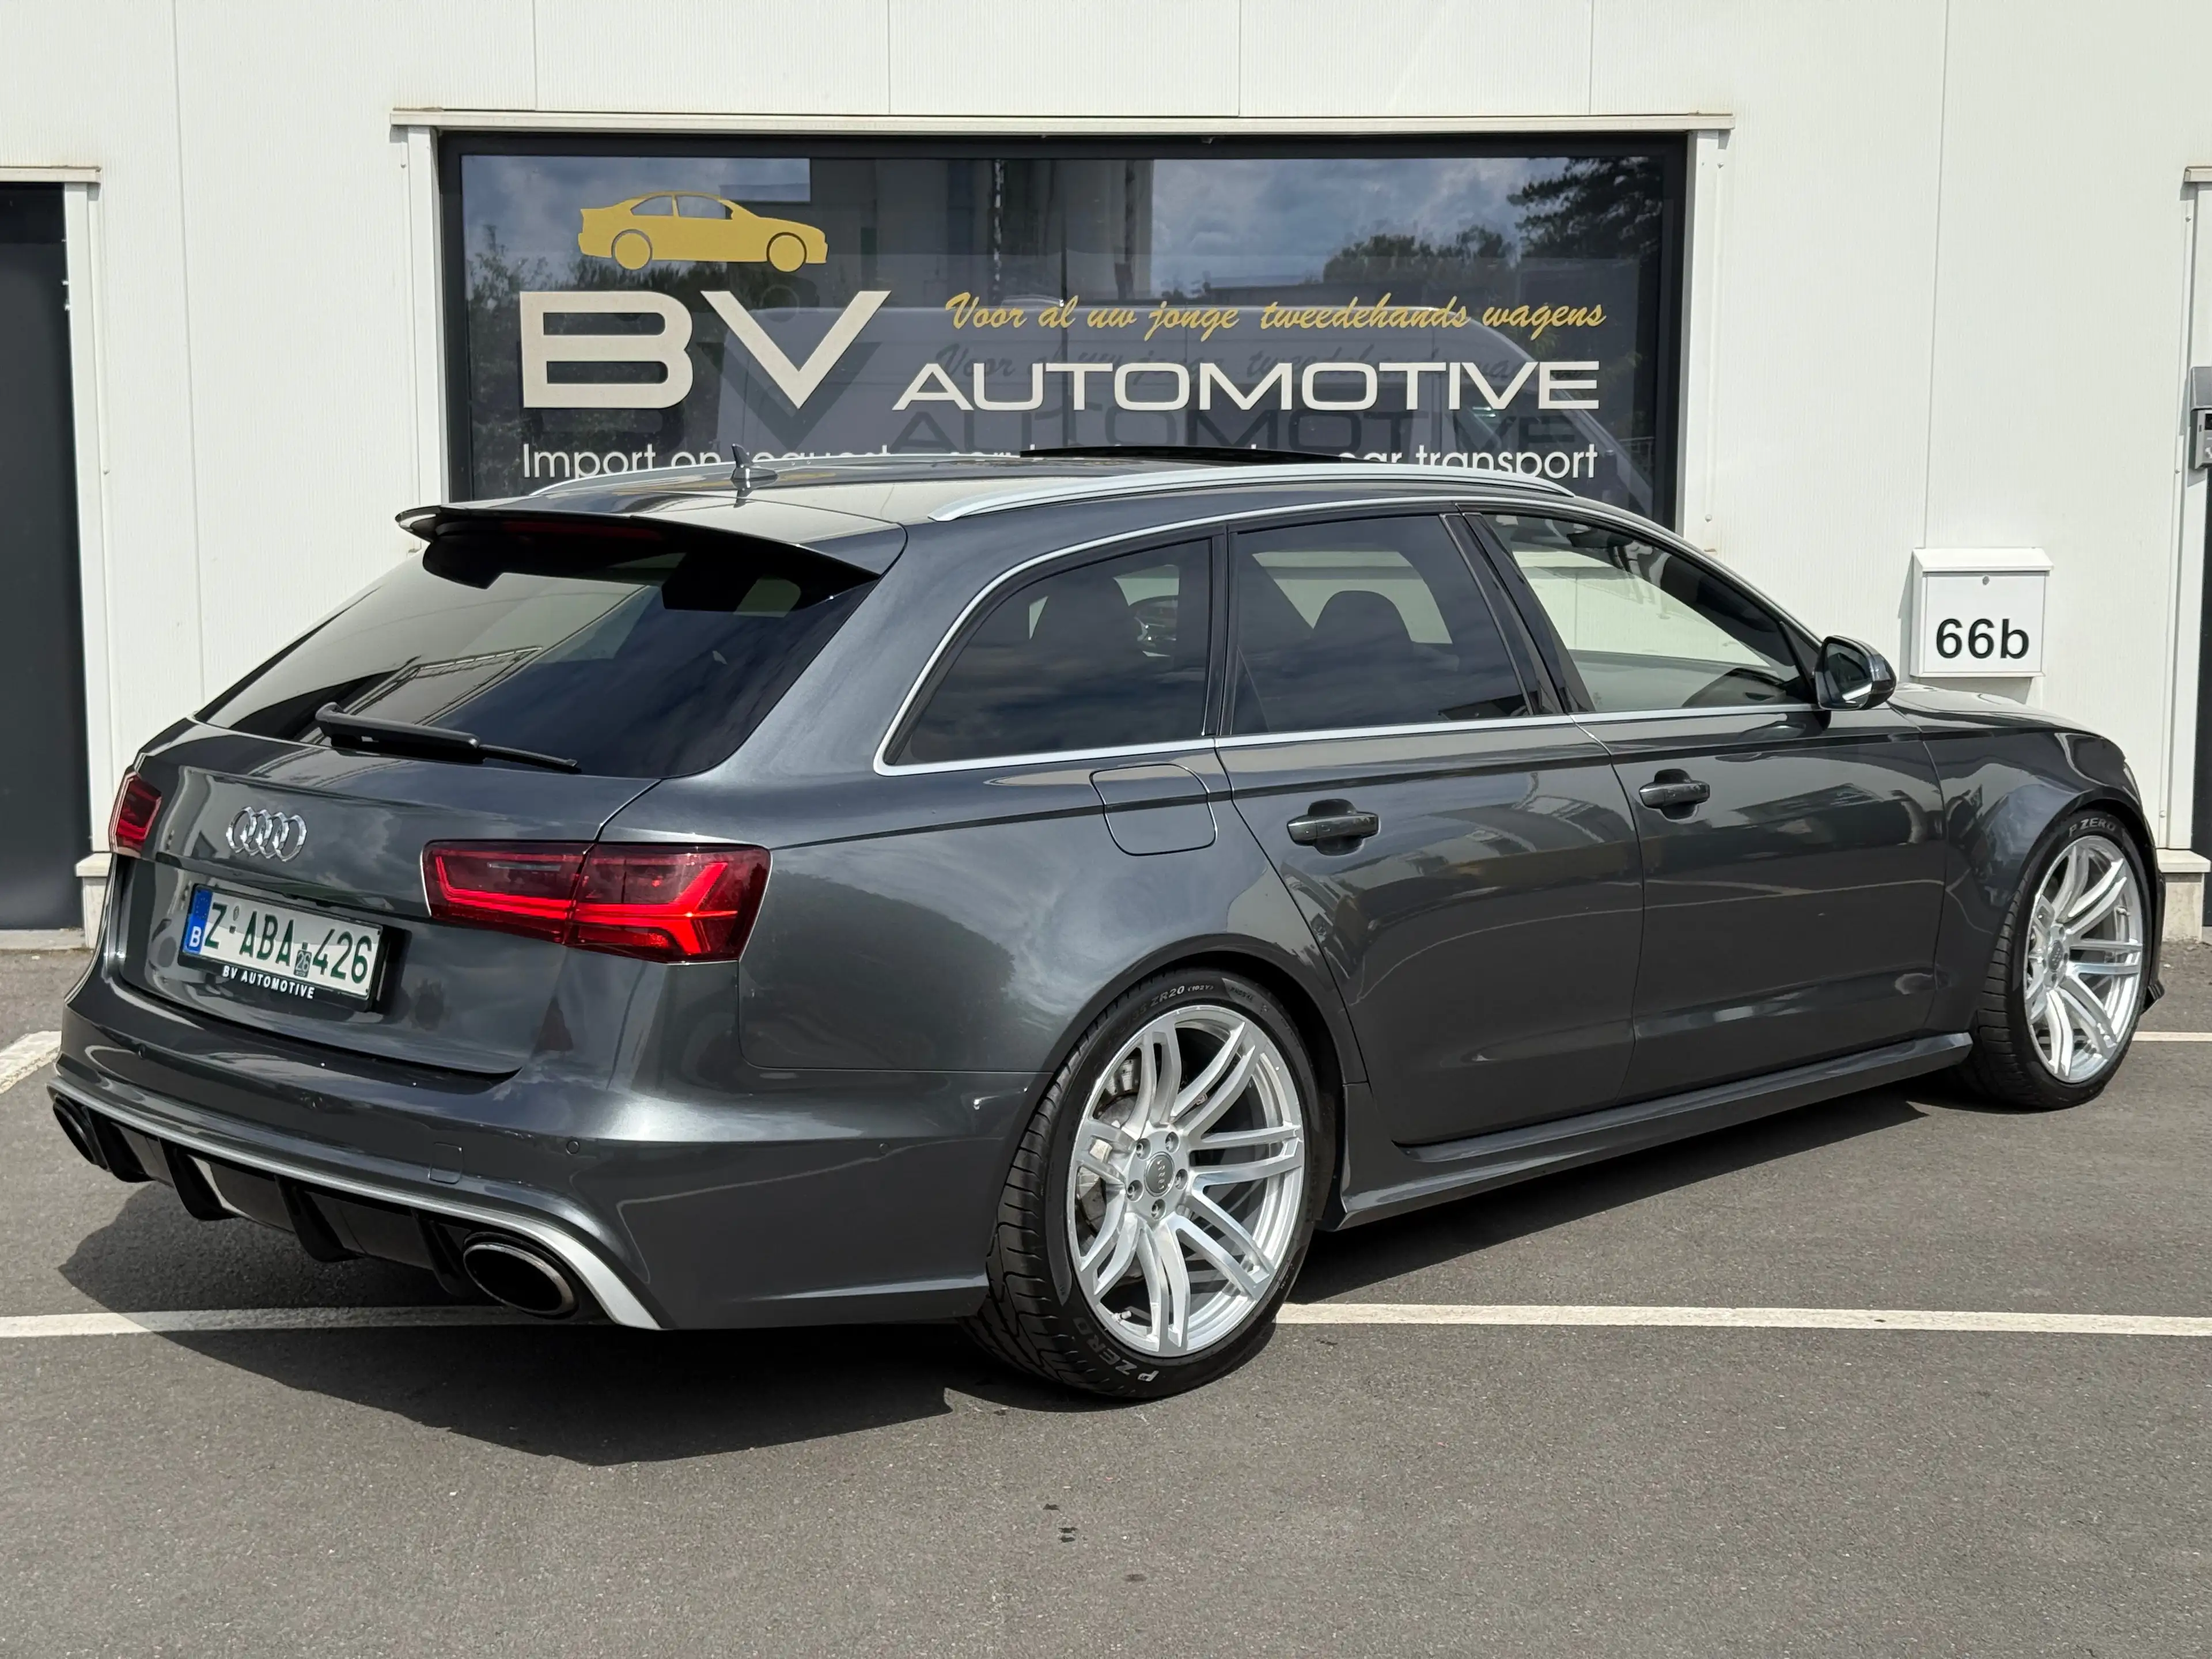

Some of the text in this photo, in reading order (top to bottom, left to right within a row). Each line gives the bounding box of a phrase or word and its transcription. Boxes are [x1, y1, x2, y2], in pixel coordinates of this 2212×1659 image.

[945, 292, 1607, 342] Voor al uw jonge tweedehands wagens
[521, 291, 892, 409] BV
[892, 361, 1600, 411] AUTOMOTIVE
[523, 443, 656, 478] Import
[1415, 443, 1599, 479] transport
[1936, 618, 2029, 660] 66b
[2080, 817, 2116, 831] ZERO
[190, 926, 202, 948] B
[222, 964, 316, 1000] BV AUTOMOTIVE
[1150, 985, 1185, 1007] ZR20
[1072, 1316, 1160, 1382] P ZERO
